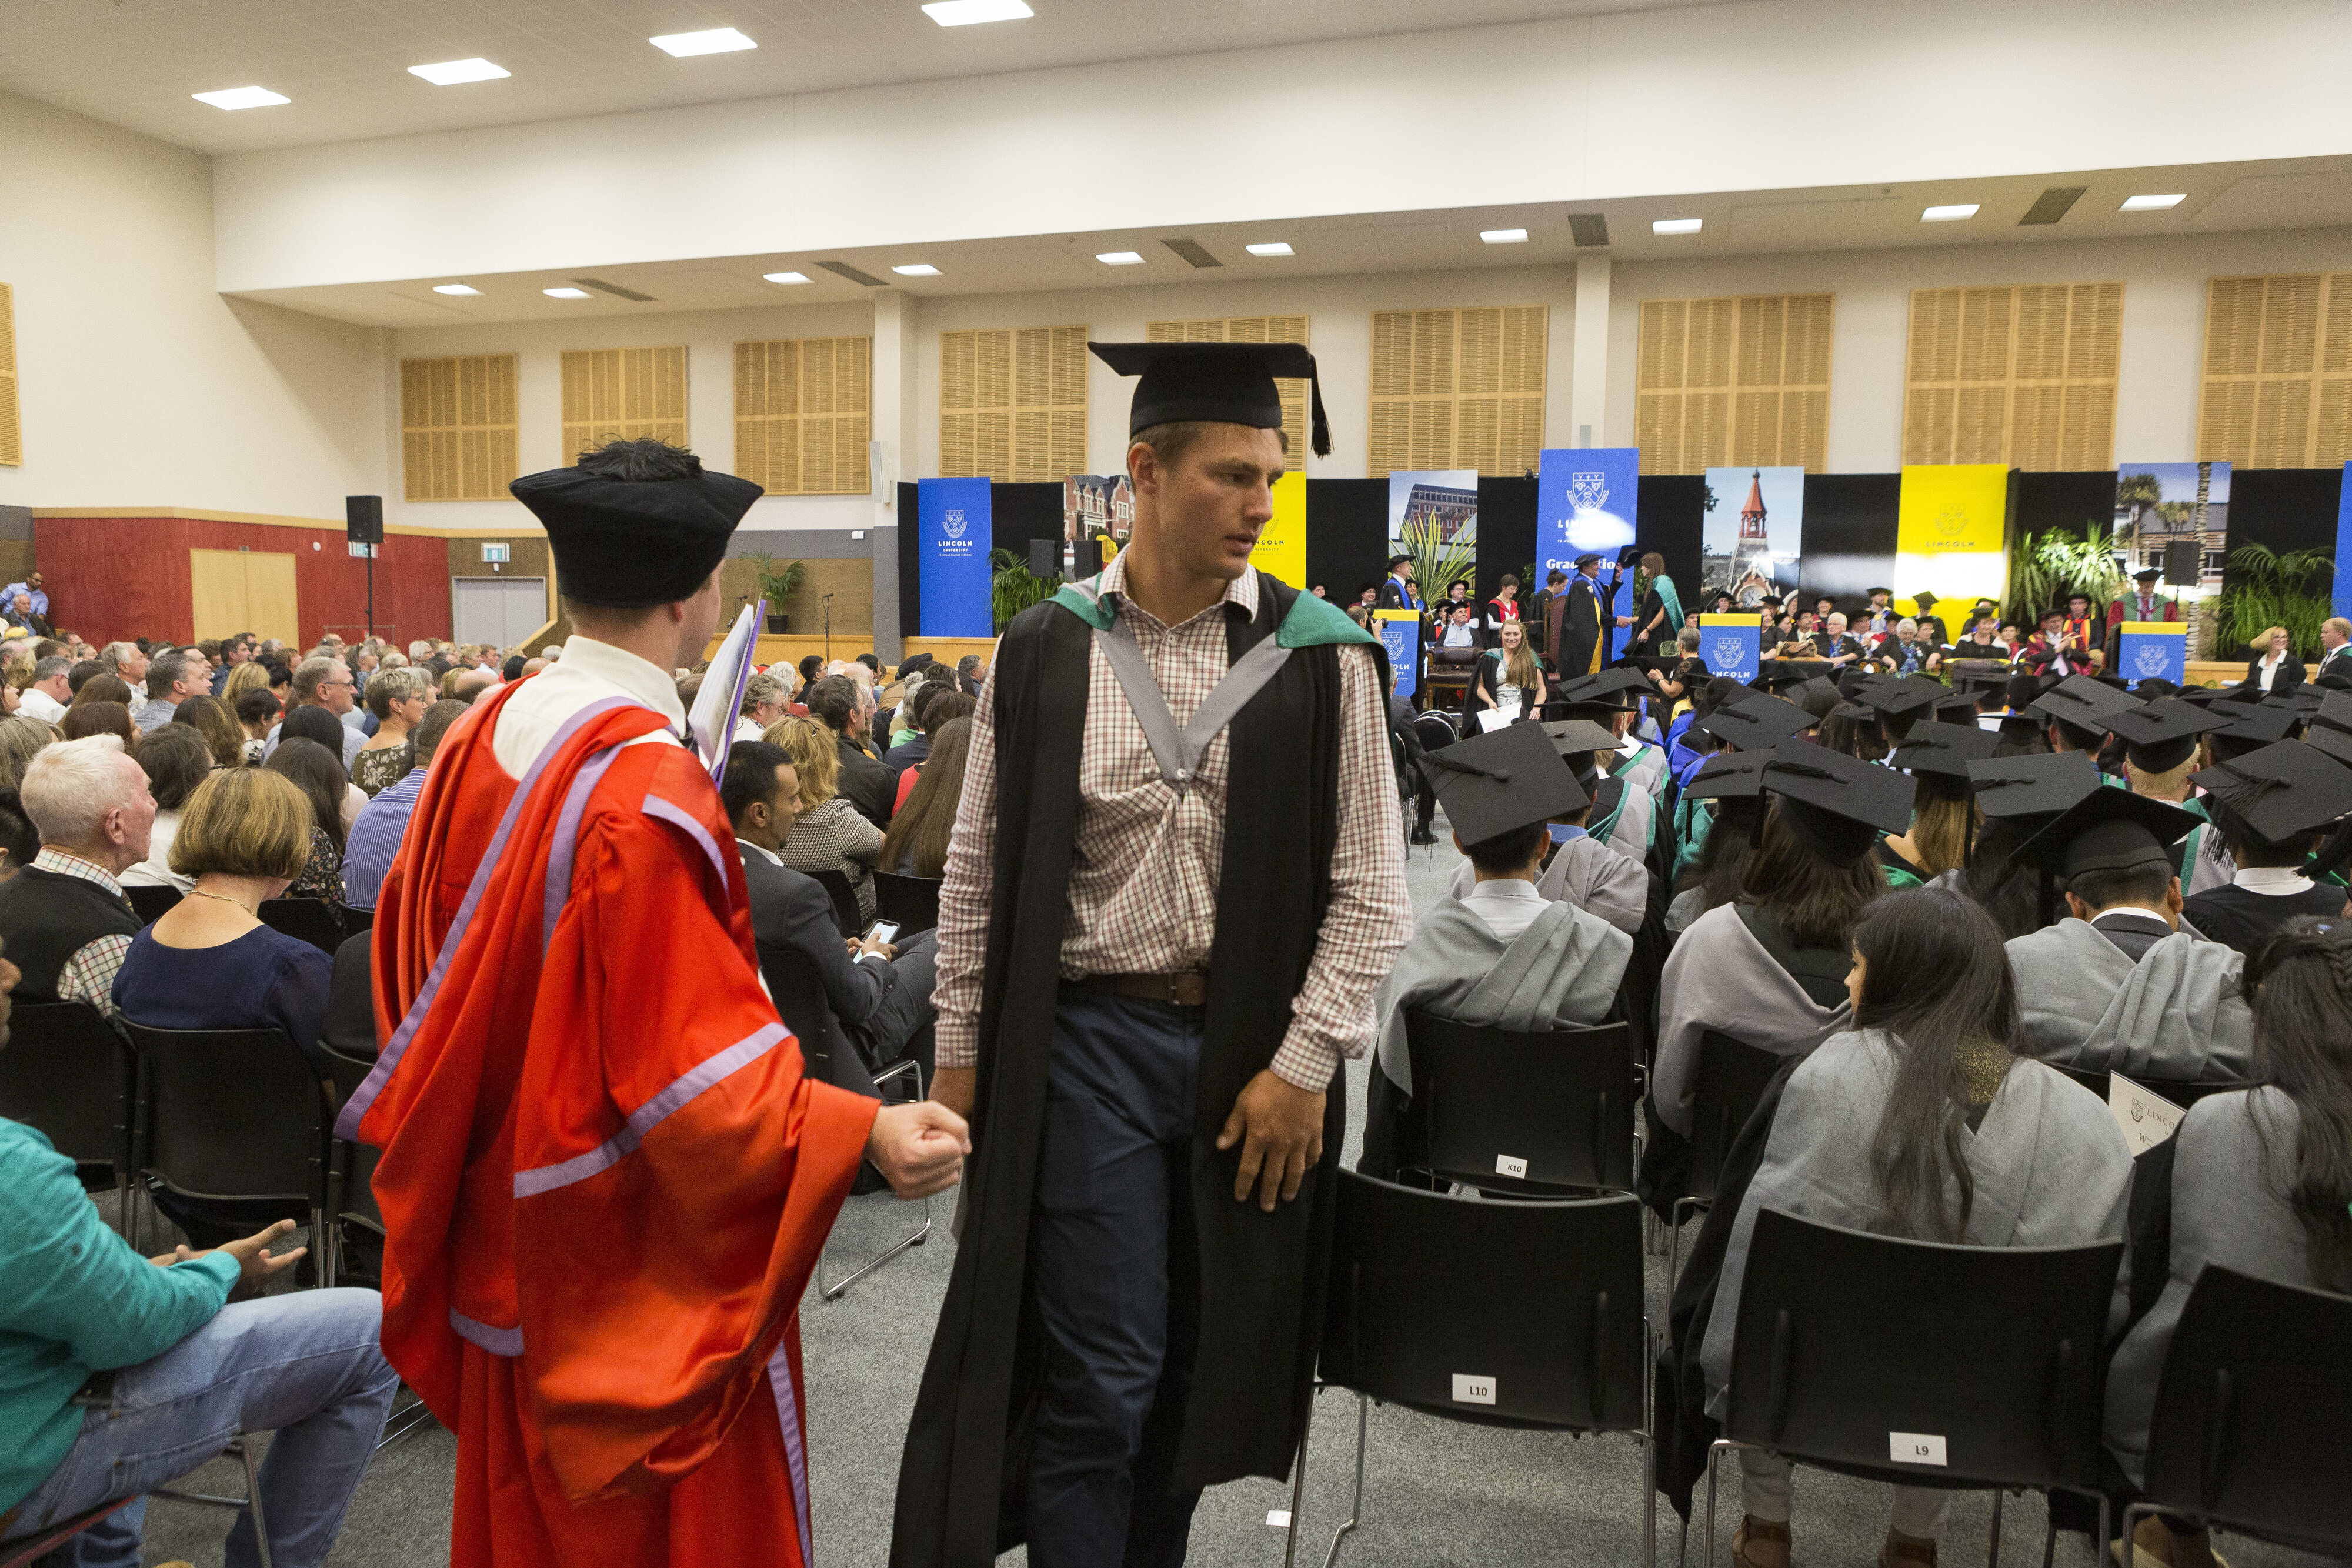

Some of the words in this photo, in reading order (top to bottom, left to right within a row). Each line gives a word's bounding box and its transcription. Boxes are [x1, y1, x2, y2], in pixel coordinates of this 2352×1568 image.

[2147, 1108, 2175, 1129] LINCO
[1507, 1164, 1522, 1172] K10
[1470, 1386, 1487, 1396] L10
[1916, 1444, 1929, 1456] L9
